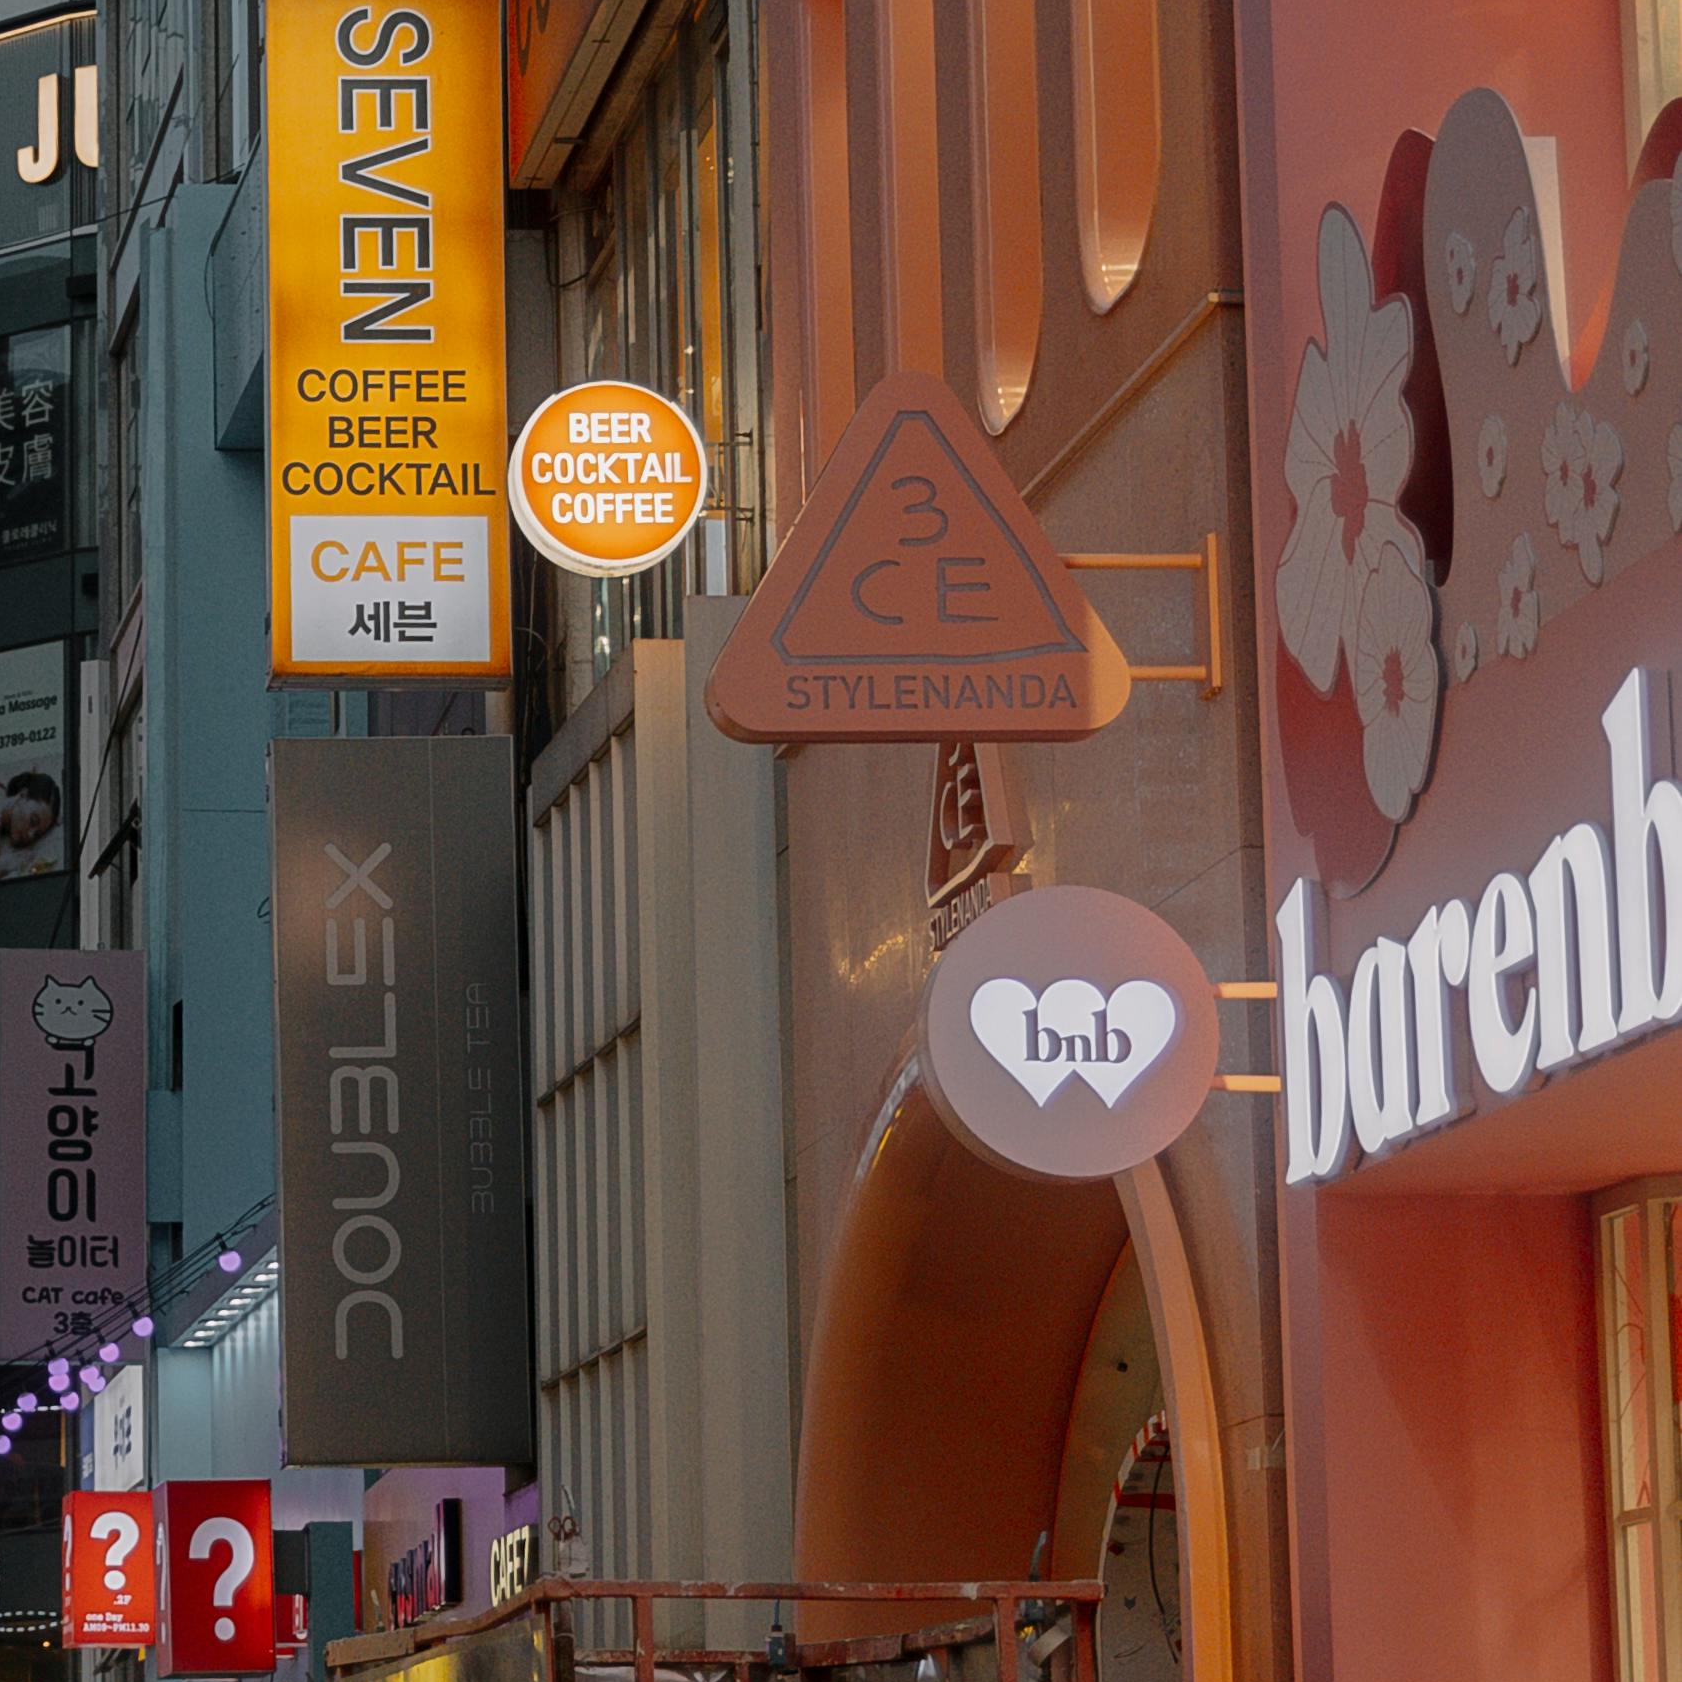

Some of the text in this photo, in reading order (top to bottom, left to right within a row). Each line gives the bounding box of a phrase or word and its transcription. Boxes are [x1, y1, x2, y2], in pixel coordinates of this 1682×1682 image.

[336, 5, 434, 344] SEVEN
[297, 369, 467, 404] COFFEE
[328, 416, 438, 449] BEER
[568, 412, 651, 445] BEER
[282, 461, 497, 497] COCKTAIL
[531, 453, 693, 486] COCKTAIL
[551, 492, 674, 526] COFFEE
[891, 476, 950, 548] 3
[310, 540, 467, 583] CAFE
[851, 557, 1000, 625] CE
[348, 599, 438, 645] 세븐
[8, 694, 58, 714] Massage
[786, 674, 1078, 711] STYLENANDA
[1023, 1008, 1133, 1064] bnb
[324, 842, 404, 1361] DOUBLEX
[47, 1044, 99, 1223] 고양이
[26, 1234, 119, 1269] 놀이터
[22, 1286, 125, 1306] CAT cafe
